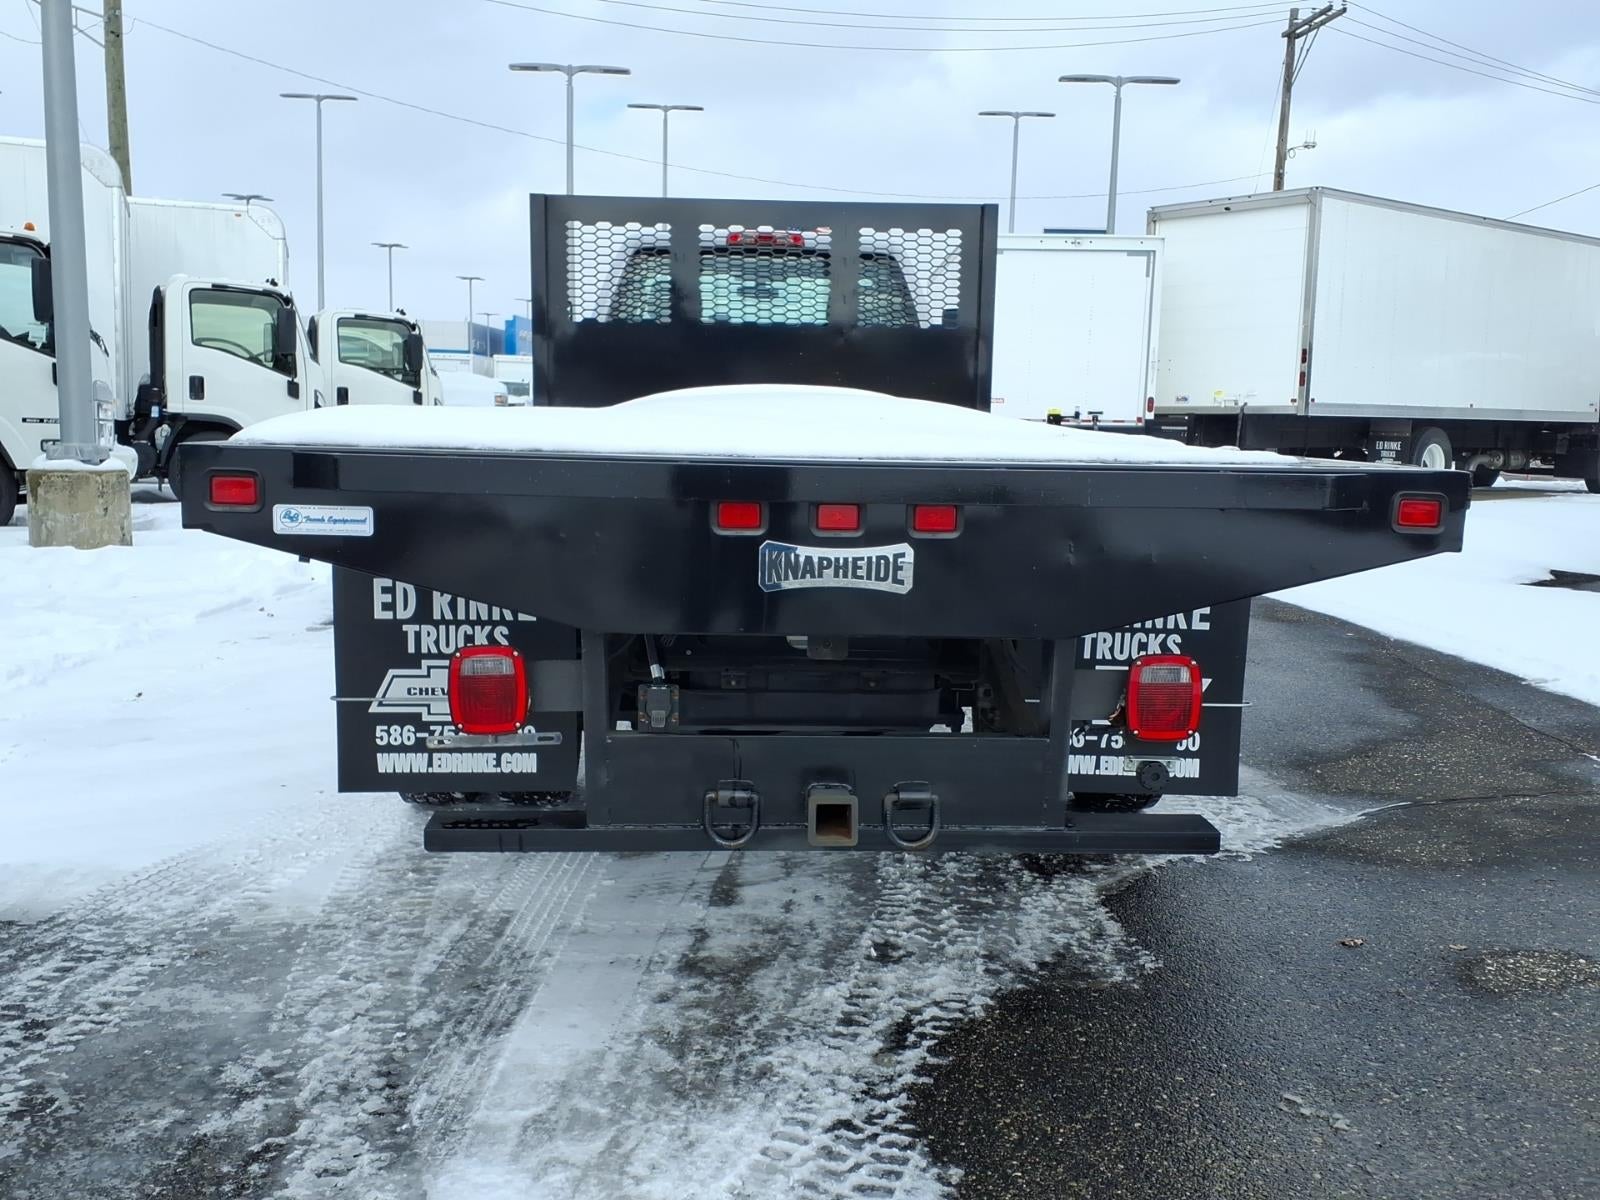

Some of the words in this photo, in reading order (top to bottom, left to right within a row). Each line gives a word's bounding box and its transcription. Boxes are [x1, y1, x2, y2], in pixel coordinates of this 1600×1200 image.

[766, 549, 906, 586] KNAPHEIDE
[373, 577, 416, 620] ED
[402, 624, 509, 654] TRUCKS
[1080, 631, 1182, 661] TRUCKS
[376, 752, 537, 773] WWW.EDRINKE.COM
